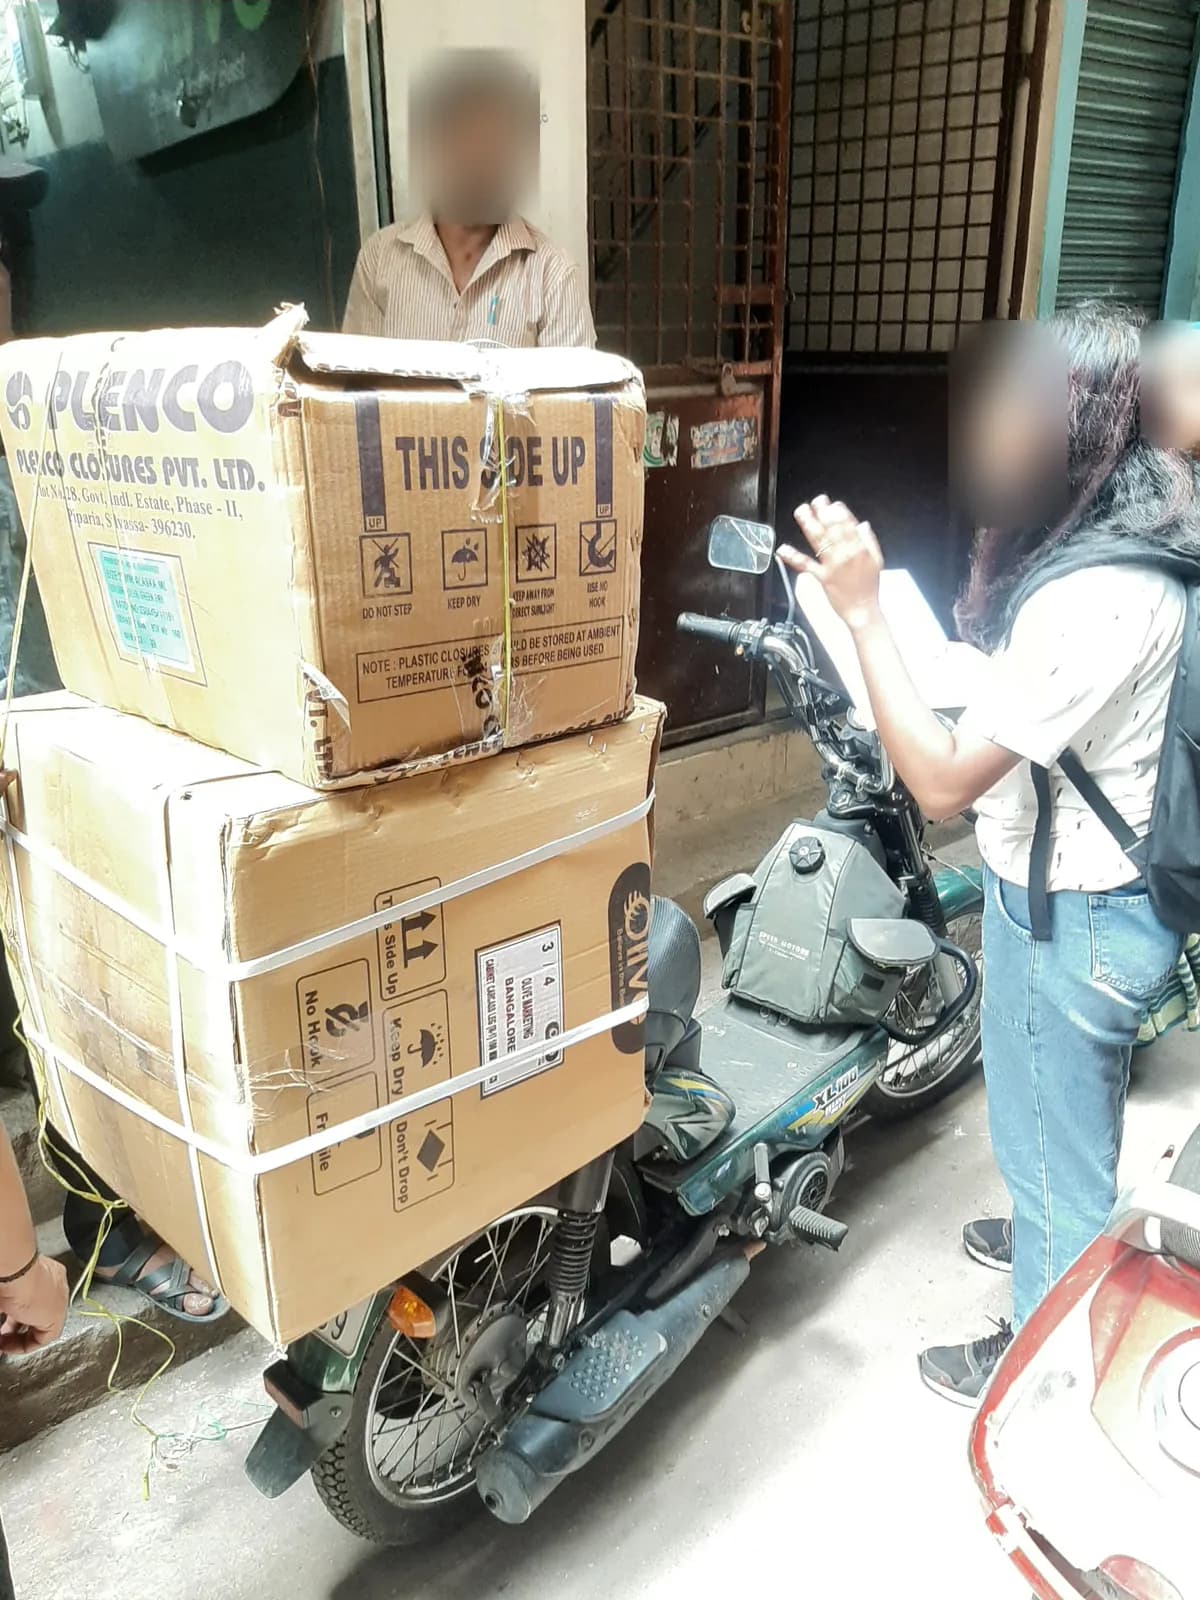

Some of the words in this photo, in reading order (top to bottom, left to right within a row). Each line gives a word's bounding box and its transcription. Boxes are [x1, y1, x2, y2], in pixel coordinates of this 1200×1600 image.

[46, 360, 254, 433] PLENCO
[162, 456, 208, 489] PVT.
[213, 458, 266, 492] LTD.
[395, 436, 470, 491] THIS
[479, 436, 544, 489] SDE
[551, 436, 586, 486] UP
[135, 492, 174, 514] Estate,
[176, 495, 213, 516] Phase
[599, 504, 610, 515] UP
[104, 512, 149, 532] Slvassa-
[151, 518, 196, 539] 396230.
[368, 517, 382, 529] UP
[447, 597, 465, 609] KEEP
[466, 595, 481, 608] DRY
[526, 589, 540, 600] AWAY
[541, 587, 555, 598] FROM
[589, 596, 606, 608] HOOK
[362, 607, 375, 619] DO
[376, 606, 392, 618] NOT
[394, 603, 413, 616] STEP
[362, 659, 391, 674] NOTE
[399, 652, 439, 669] PLASTIC
[530, 638, 541, 649] BE
[543, 633, 575, 647] STORED
[576, 631, 586, 642] AT
[587, 624, 621, 640] AMBIENT
[522, 653, 556, 667] BEFORE
[557, 649, 582, 662] BEING
[583, 643, 604, 657] USED
[382, 895, 395, 930] Ts
[384, 934, 397, 969] Side
[541, 941, 554, 953] 3
[386, 975, 398, 995] Up
[543, 976, 556, 986] 4
[305, 990, 318, 1016] No
[504, 977, 516, 1053] BANGALORE
[392, 1067, 405, 1096] Dry
[316, 1112, 330, 1171] Frile
[396, 1121, 408, 1164] Don't
[398, 1167, 410, 1203] Drop
